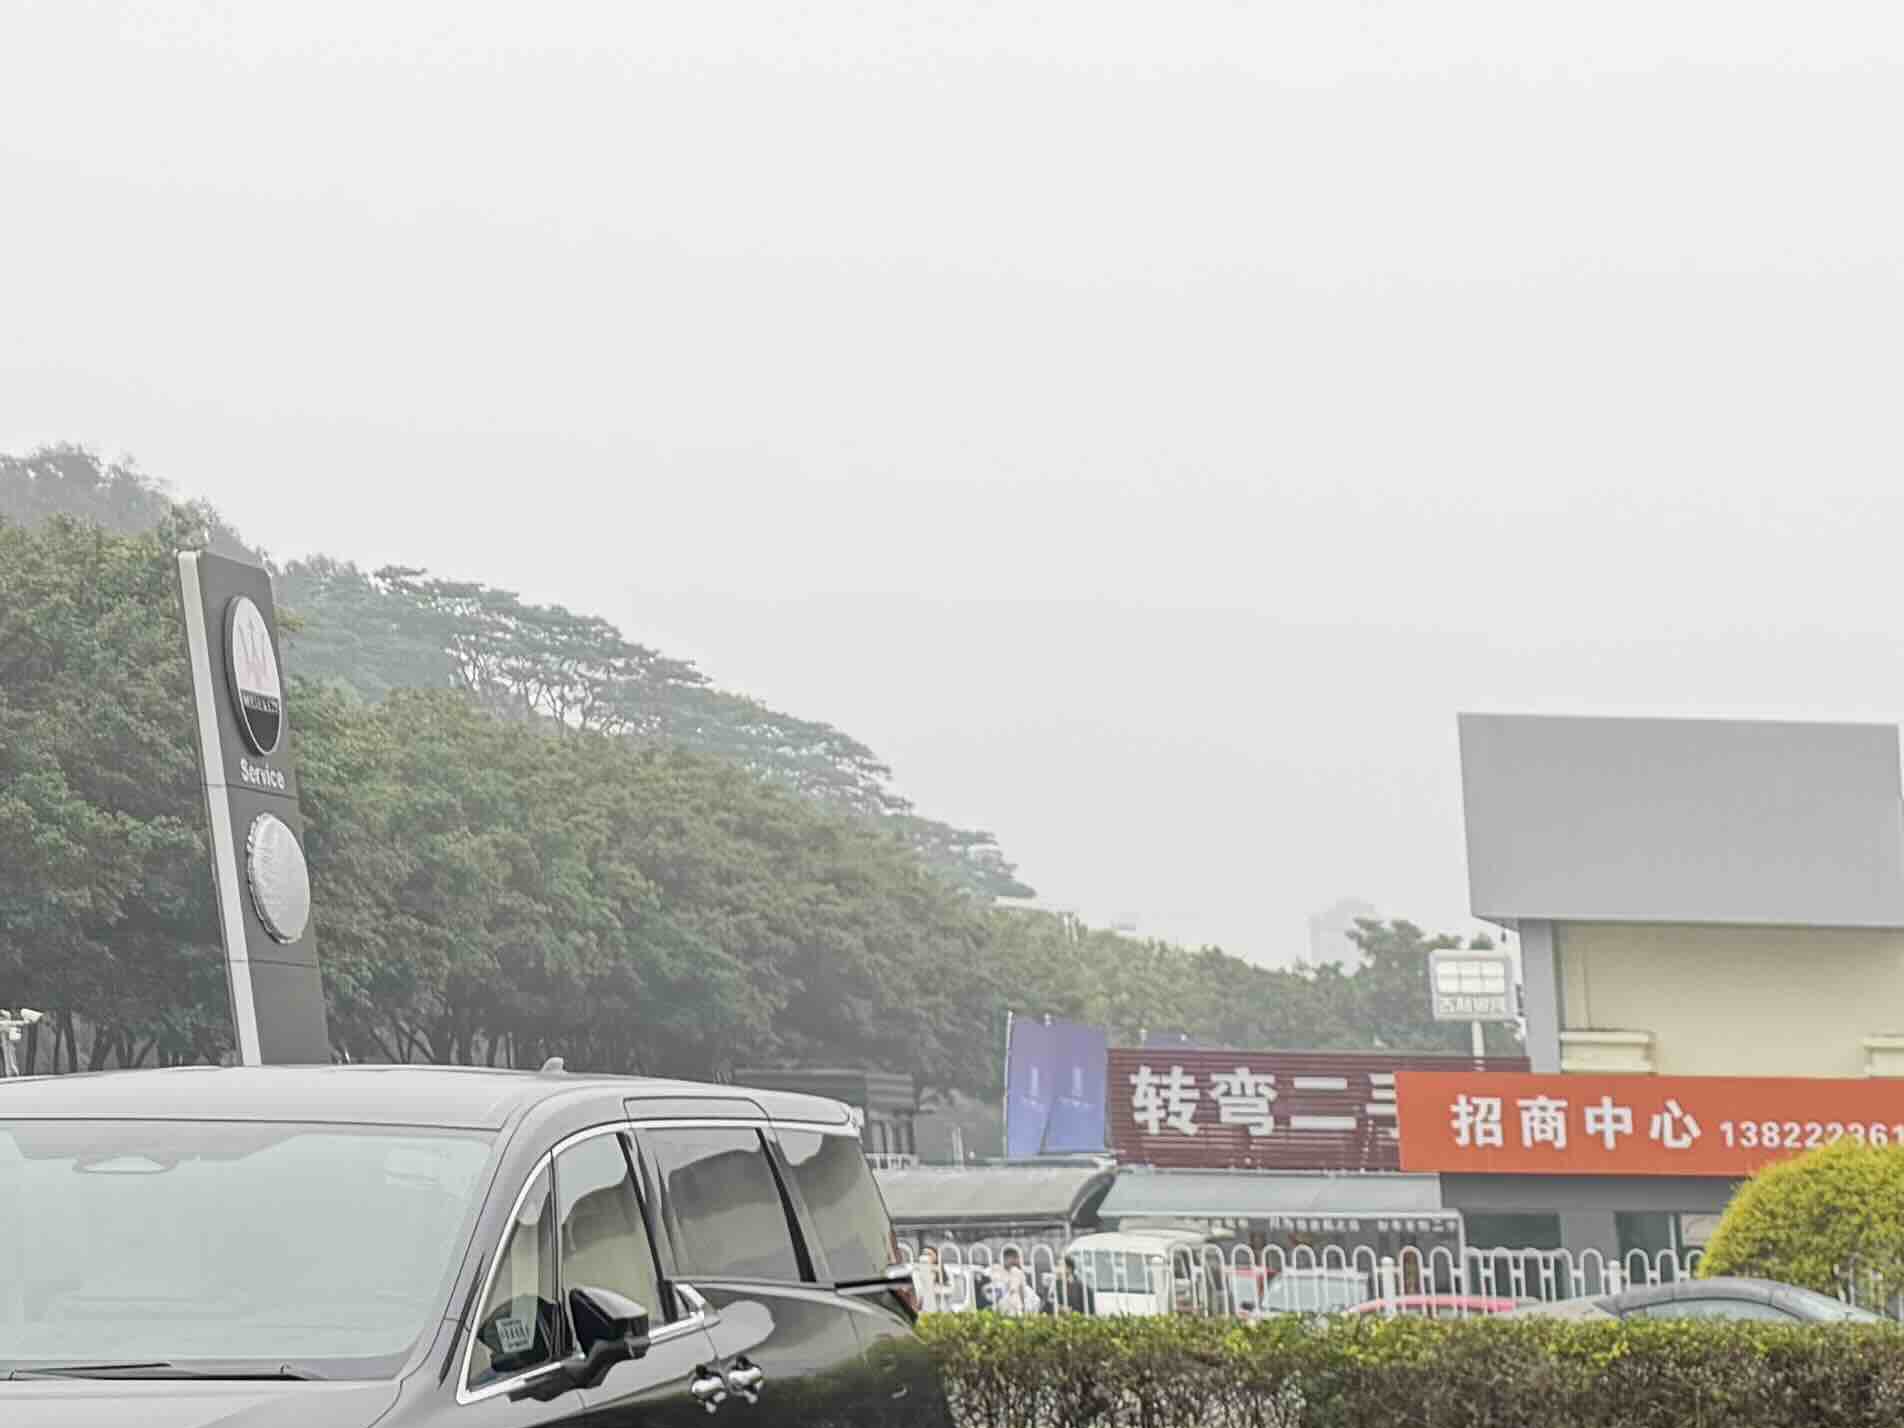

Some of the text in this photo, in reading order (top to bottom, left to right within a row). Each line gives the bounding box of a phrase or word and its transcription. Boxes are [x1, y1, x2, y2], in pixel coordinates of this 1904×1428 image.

[239, 756, 286, 790] Service
[1449, 1093, 1702, 1150] 招商中心
